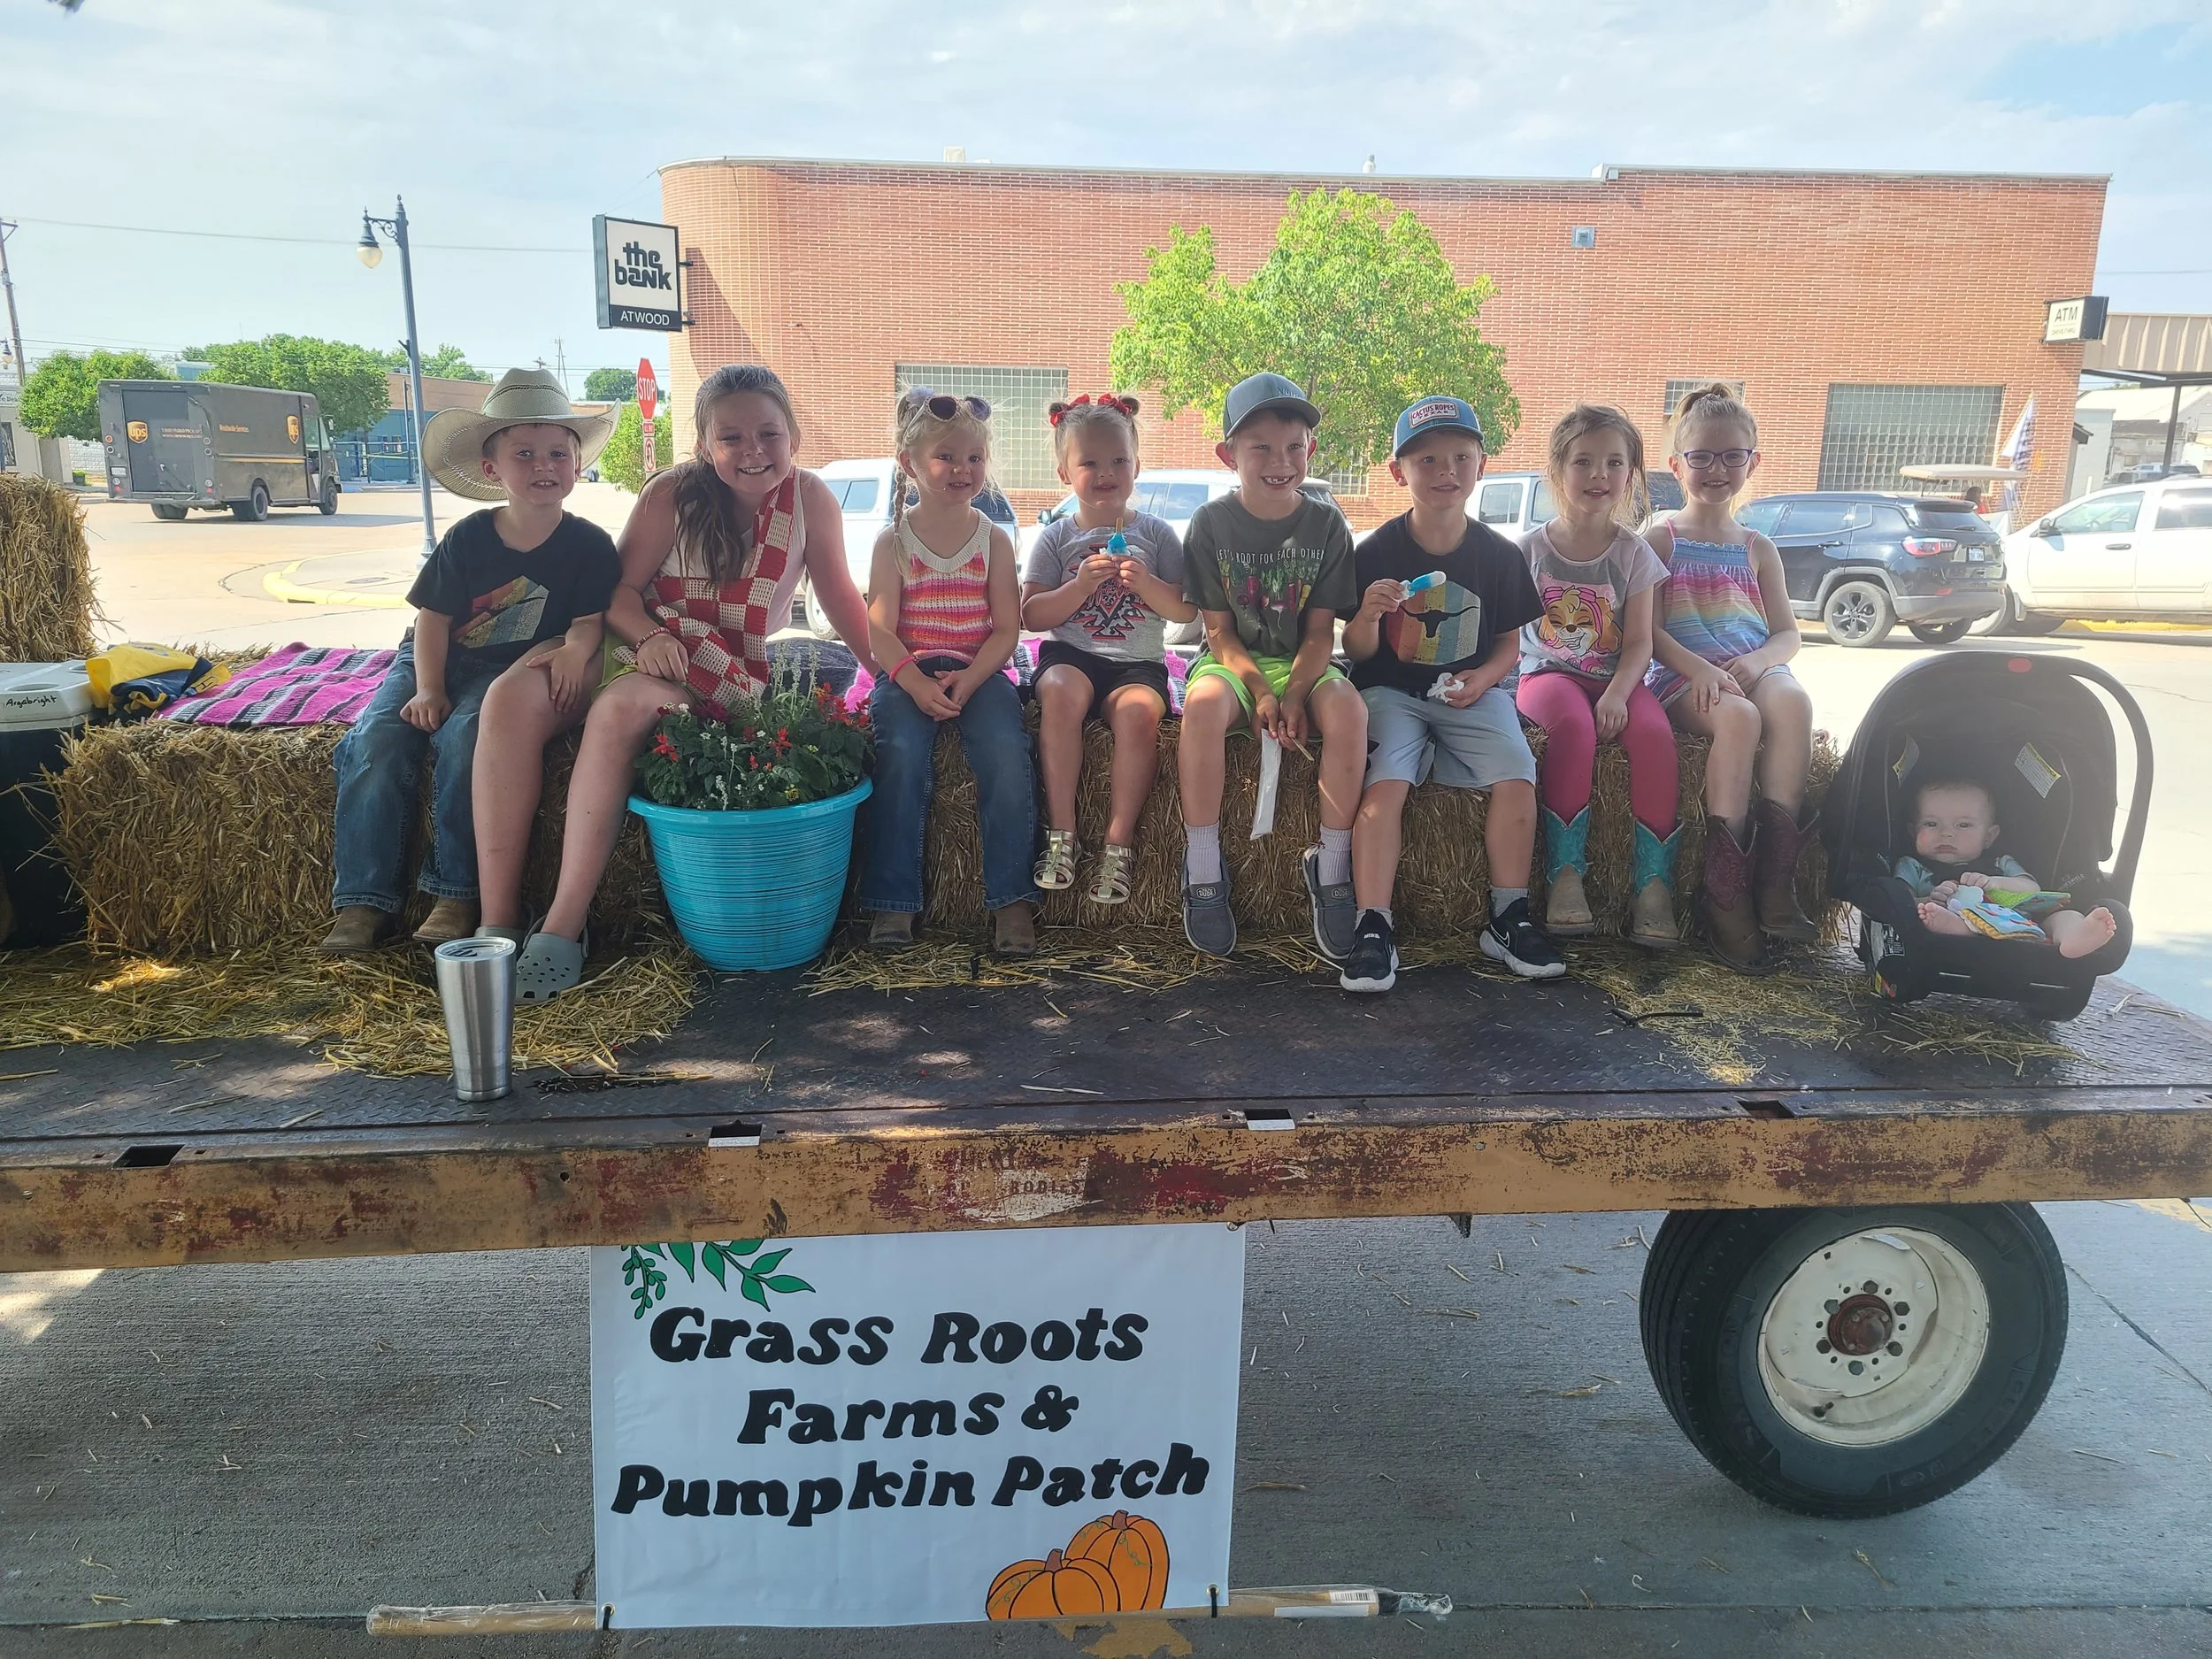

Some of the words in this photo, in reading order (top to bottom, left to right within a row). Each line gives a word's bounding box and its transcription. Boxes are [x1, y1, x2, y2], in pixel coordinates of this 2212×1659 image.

[622, 241, 663, 269] the
[620, 310, 670, 326] ATWOOD
[2055, 306, 2078, 322] ATM
[638, 377, 656, 402] STOP
[1412, 404, 1434, 419] CACTUS
[130, 427, 148, 440] ups
[288, 424, 299, 439] ups
[1236, 552, 1256, 564] ROOT
[1259, 552, 1274, 565] FOR
[1277, 548, 1296, 560] EACH
[5, 695, 58, 709] Argabright
[649, 1306, 895, 1366] Grass
[920, 1308, 1149, 1364] Roots
[736, 1388, 1005, 1445] Farms
[1020, 1384, 1079, 1432] &
[611, 1459, 976, 1527] Pumpkin
[990, 1442, 1210, 1507] Patch
